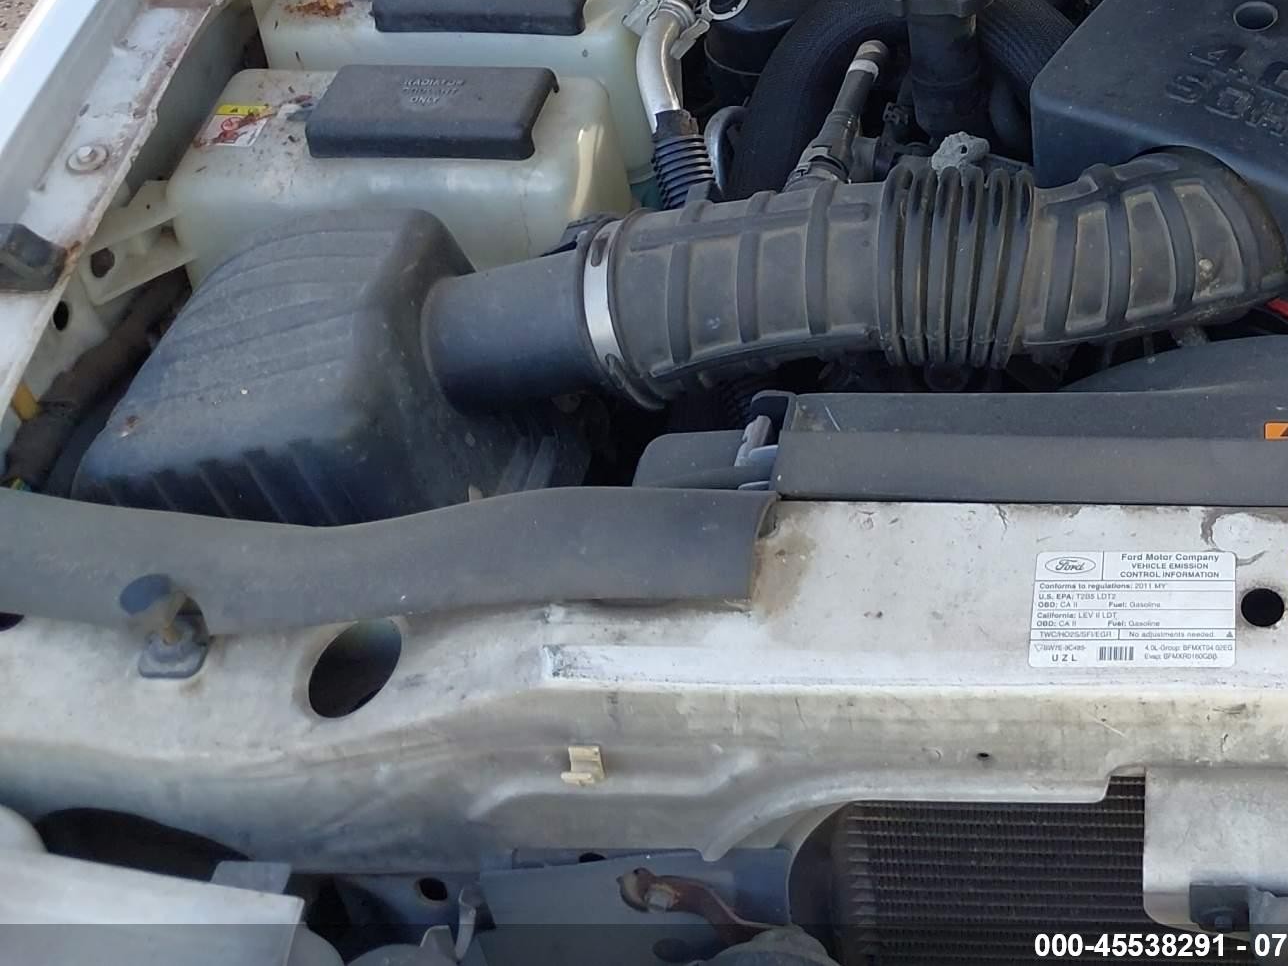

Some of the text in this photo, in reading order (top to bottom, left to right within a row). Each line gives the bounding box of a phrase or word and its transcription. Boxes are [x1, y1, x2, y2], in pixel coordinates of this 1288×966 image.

[1121, 553, 1219, 563] Ford Motor Company
